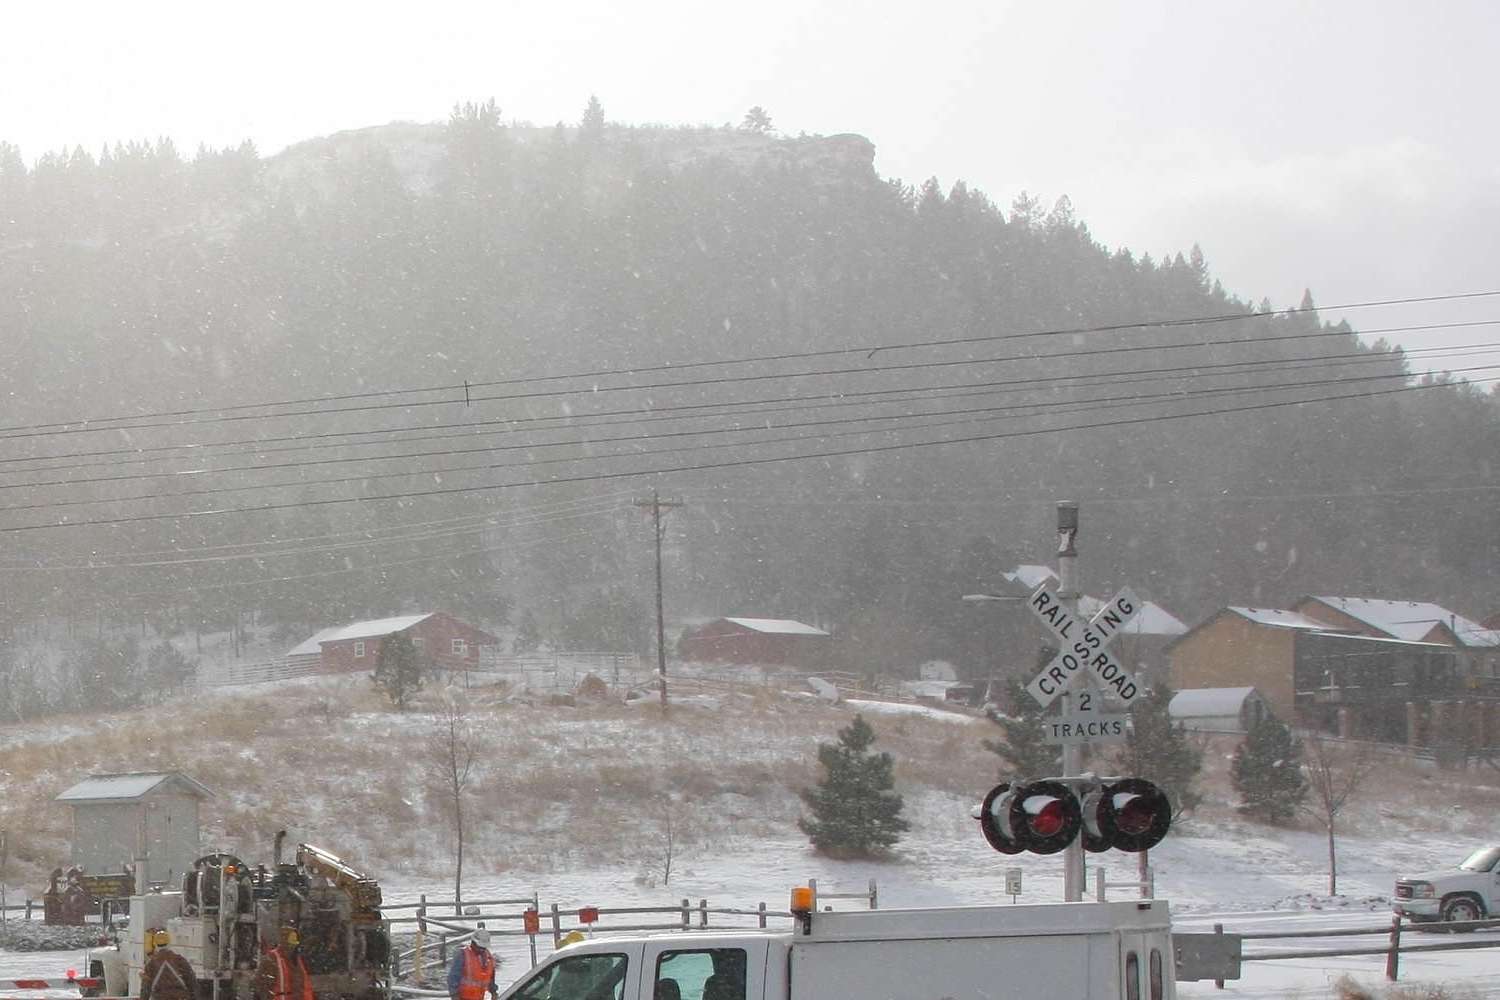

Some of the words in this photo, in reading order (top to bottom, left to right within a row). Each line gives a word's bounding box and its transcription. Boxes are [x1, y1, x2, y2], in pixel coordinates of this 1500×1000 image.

[1033, 592, 1074, 639] RAIL
[1091, 652, 1137, 700] ROAD
[1038, 597, 1134, 695] CROSSING
[1051, 721, 1122, 737] TRACKS
[1078, 693, 1092, 711] 2
